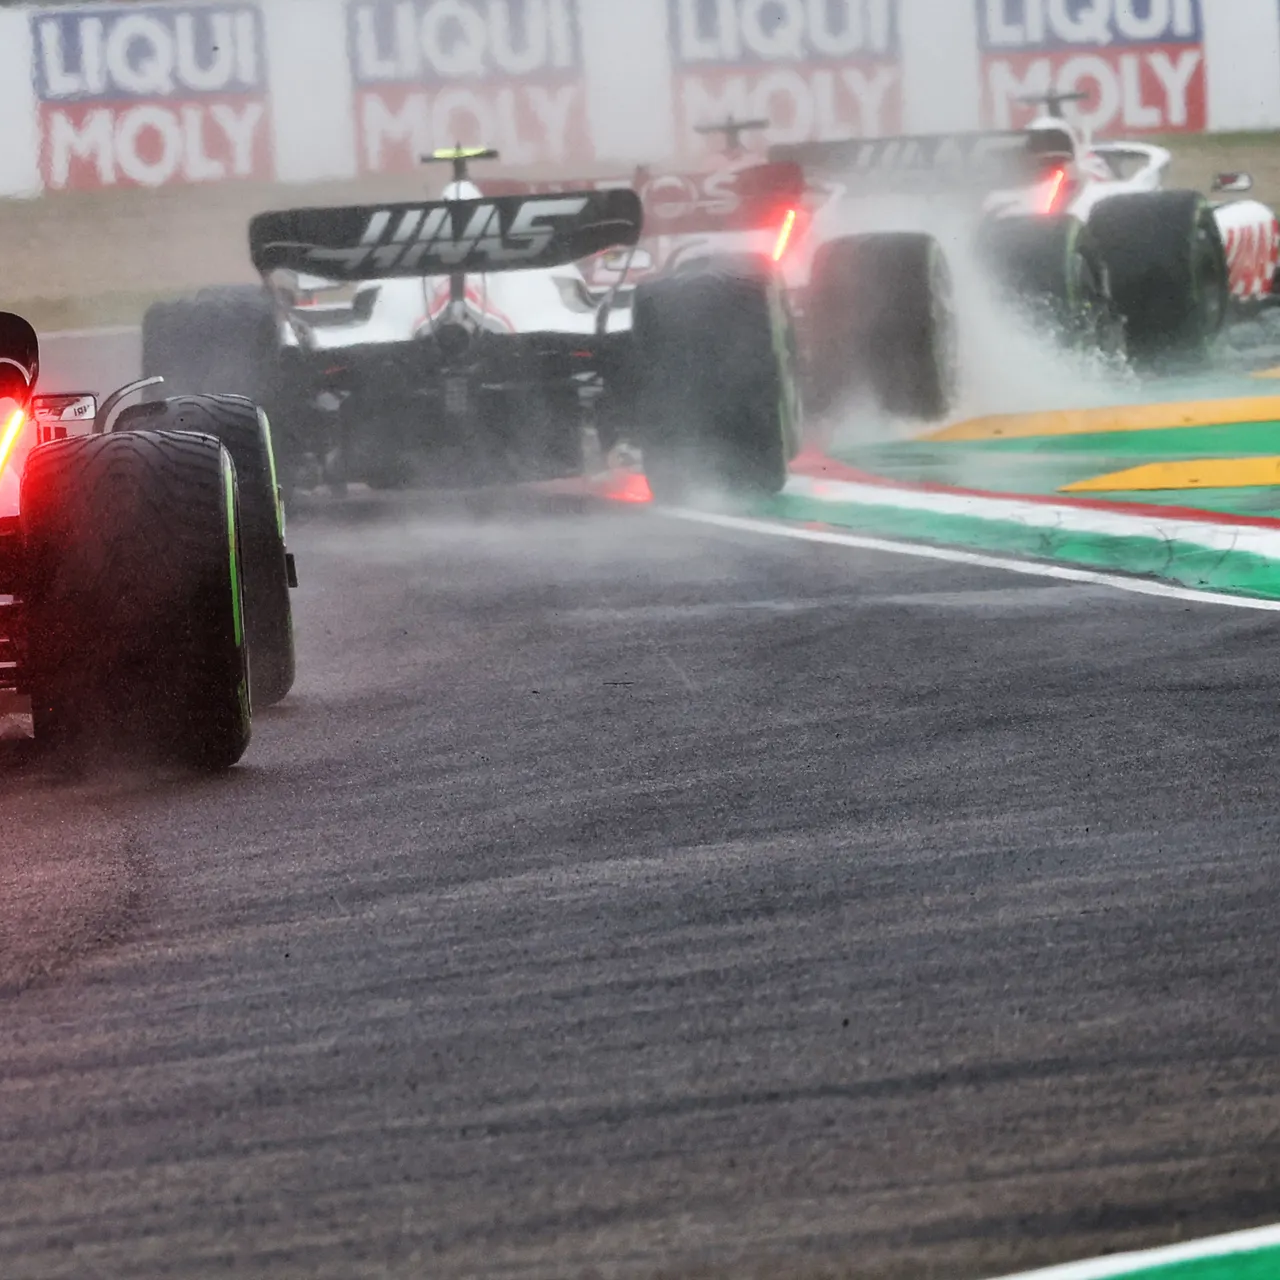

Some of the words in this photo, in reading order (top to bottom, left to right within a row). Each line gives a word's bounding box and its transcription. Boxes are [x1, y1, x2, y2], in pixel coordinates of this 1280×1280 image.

[43, 12, 256, 96] LIQUI
[990, 51, 1201, 136] MOLY
[50, 103, 263, 188] MOLY
[365, 84, 575, 170] MOLY
[685, 69, 894, 152] MOLY
[307, 198, 588, 269] HAAS
